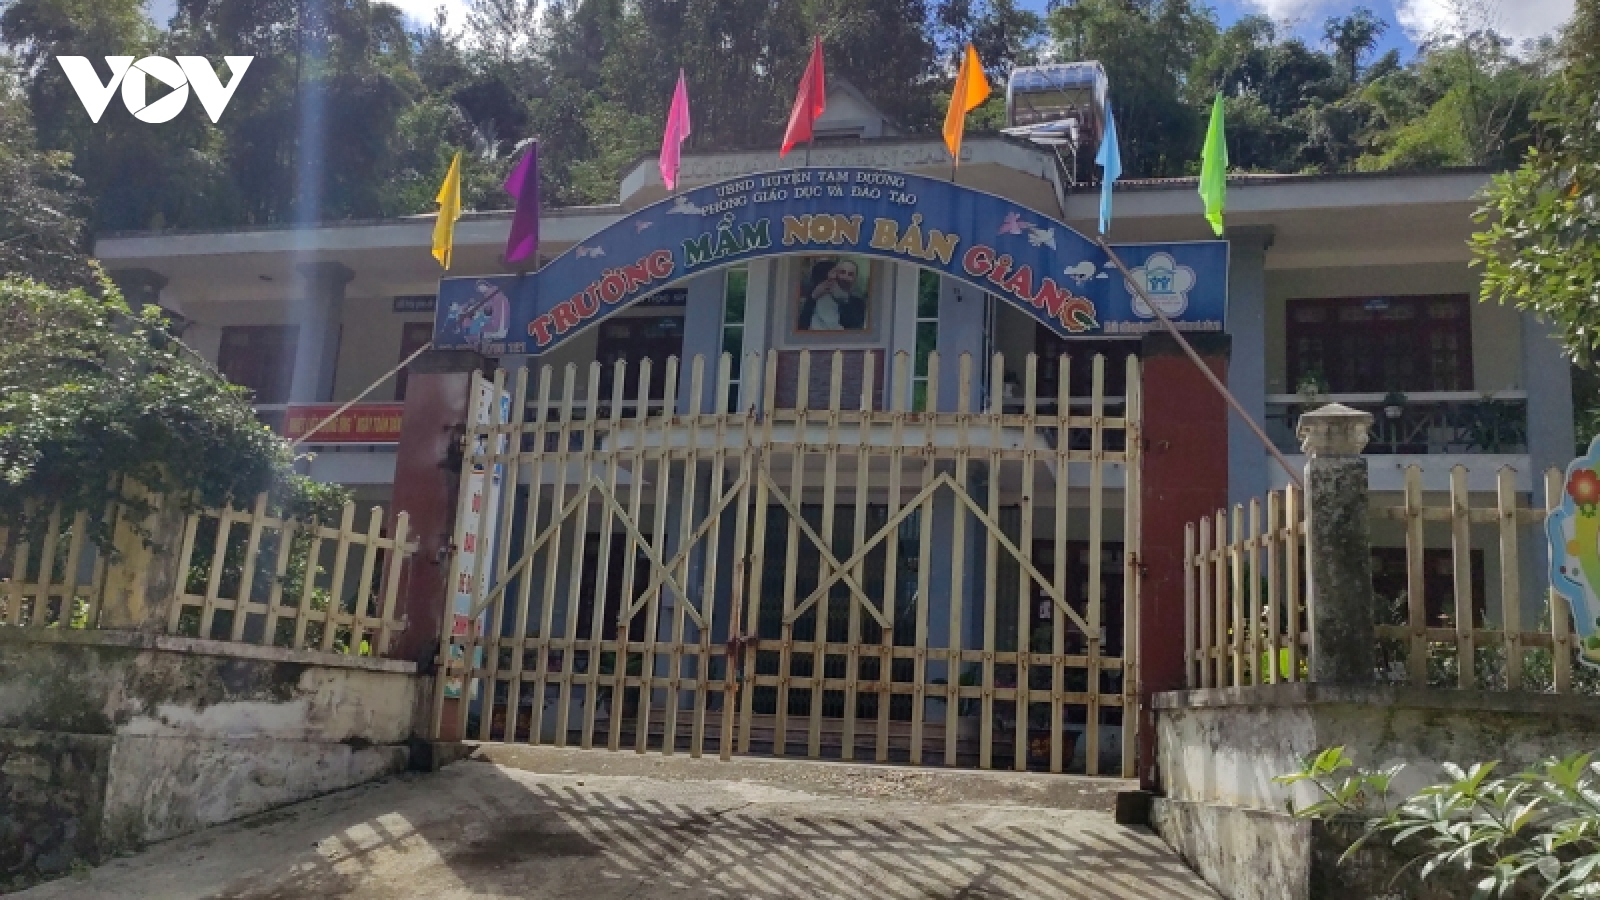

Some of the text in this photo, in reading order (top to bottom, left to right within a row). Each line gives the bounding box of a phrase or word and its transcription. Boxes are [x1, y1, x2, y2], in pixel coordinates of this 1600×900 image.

[761, 172, 811, 187] HUYỆN
[817, 171, 849, 184] TAM
[753, 187, 788, 204] GIÁO
[793, 185, 823, 200] DỤC
[827, 183, 844, 198] VÀ
[889, 189, 918, 206] TẠO
[527, 249, 675, 346] TRƯỜNG
[681, 211, 773, 268] MẦM
[781, 213, 864, 246] NON
[869, 212, 960, 265] BẢN
